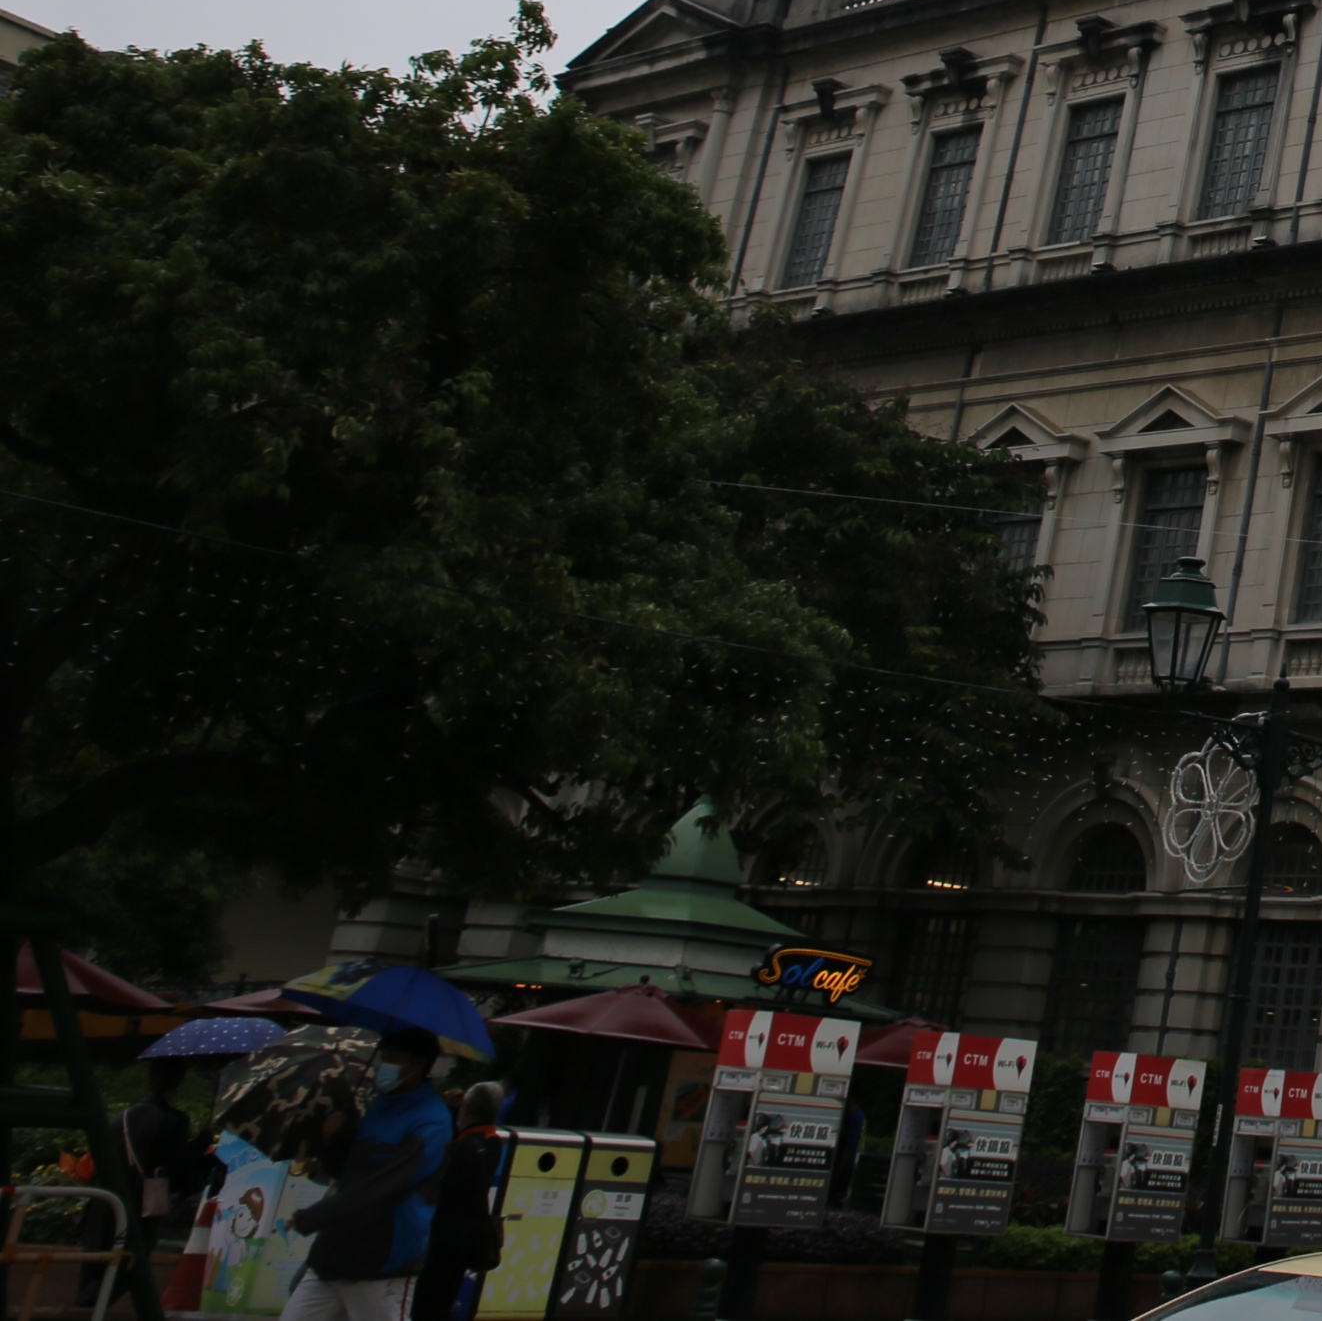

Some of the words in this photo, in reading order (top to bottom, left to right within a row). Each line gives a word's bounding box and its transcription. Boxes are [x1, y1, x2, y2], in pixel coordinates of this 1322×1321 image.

[729, 1031, 745, 1040] CTM
[777, 1033, 806, 1047] CTM
[816, 1040, 835, 1050] Wi-Fi
[916, 1051, 932, 1060] CTM
[963, 1053, 989, 1067] CTM
[997, 1060, 1015, 1069] Wi-Fi
[1095, 1070, 1110, 1078] CTM
[1140, 1073, 1163, 1085] CTM
[1171, 1079, 1186, 1087] Wi-Fi
[1244, 1085, 1259, 1093] CTM
[1288, 1088, 1308, 1099] CTM
